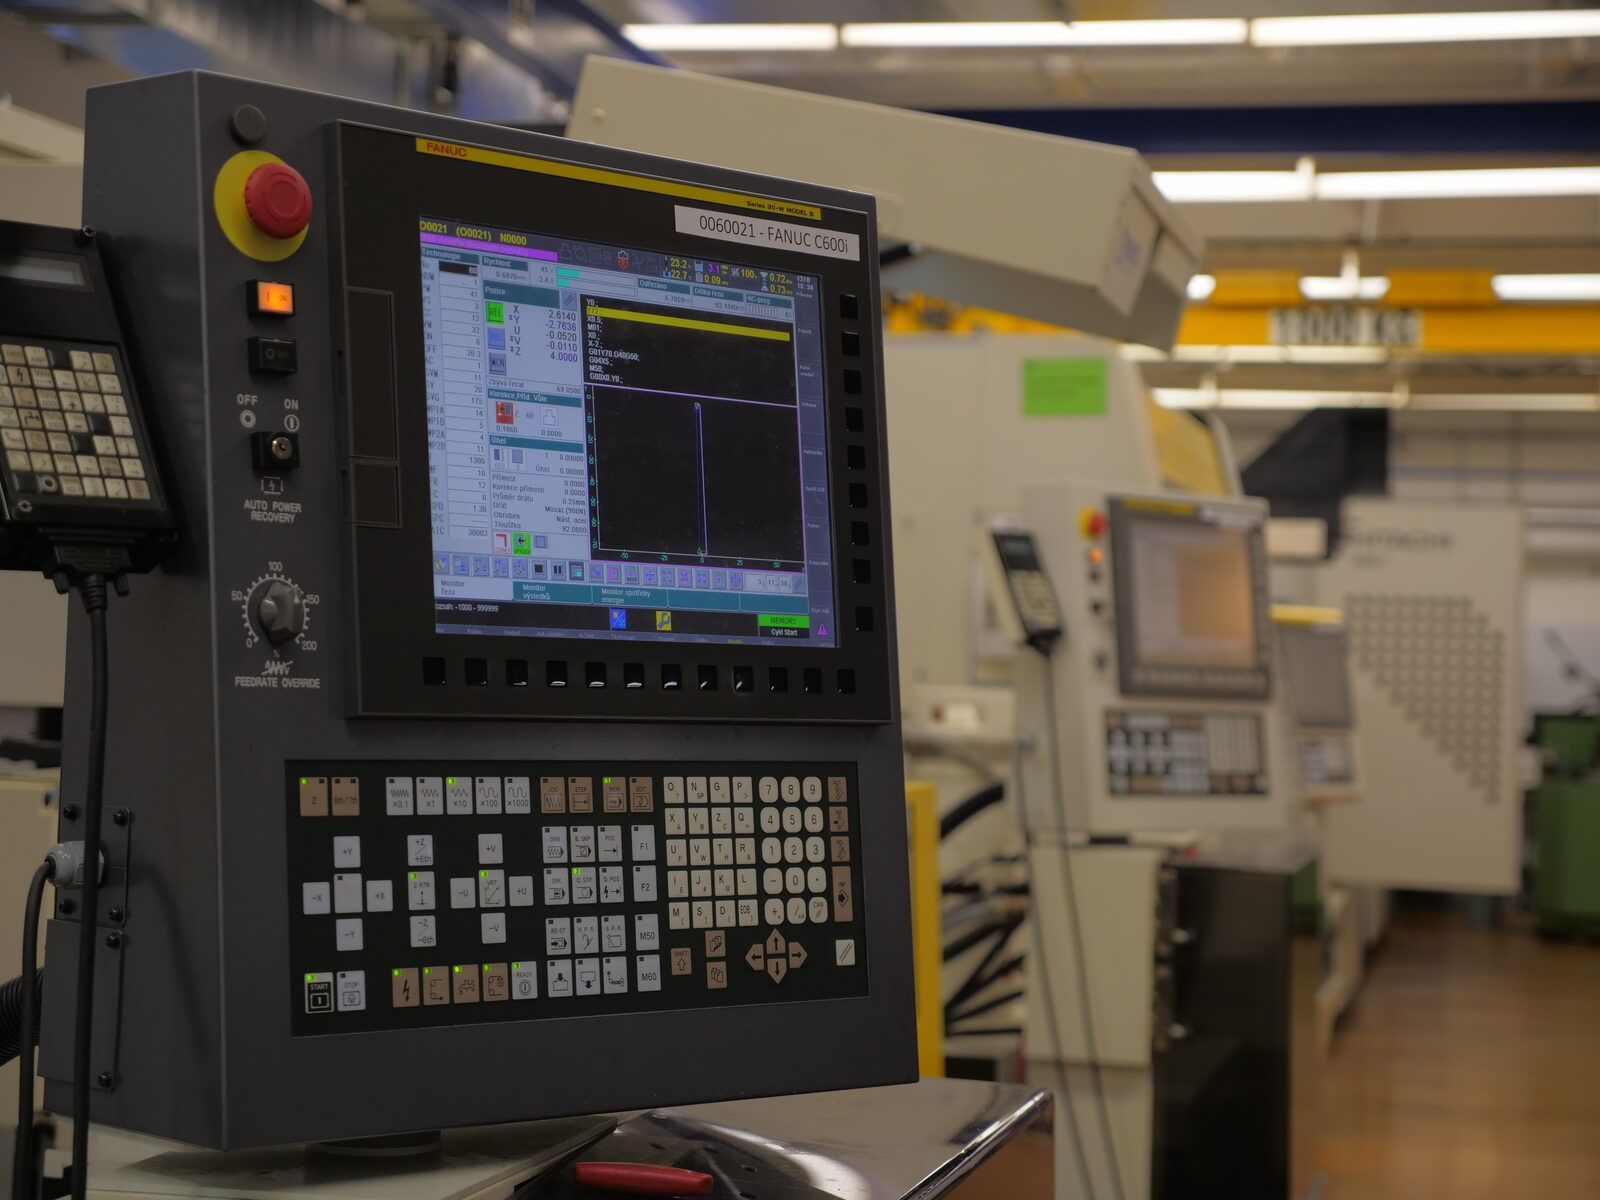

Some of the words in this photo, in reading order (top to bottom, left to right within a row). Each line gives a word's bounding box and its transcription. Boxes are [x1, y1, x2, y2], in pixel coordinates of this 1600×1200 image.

[426, 142, 467, 157] FANUC
[420, 221, 447, 233] O0021
[456, 226, 492, 242] (O0021)
[500, 233, 527, 245] N0000
[699, 215, 755, 238] 0060021
[768, 227, 810, 247] FANUC
[815, 234, 848, 253] C600i
[483, 258, 511, 267] Rychlost
[485, 287, 506, 295] Pozice
[514, 305, 519, 313] X
[549, 310, 575, 320] 2.6140
[546, 320, 576, 330] -2.7636
[514, 326, 520, 334] U
[546, 332, 577, 341] -0.0520
[547, 343, 577, 352] -0.0110
[550, 353, 577, 362] 4.0000
[489, 379, 503, 388] Zbývá
[237, 394, 258, 406] OFF
[284, 398, 298, 410] ON
[493, 483, 518, 492] Korekce
[244, 499, 267, 510] AUTO
[273, 501, 302, 512] POWER
[251, 510, 295, 523] RECOVERY
[494, 512, 520, 520] Obrobek
[269, 562, 282, 571] 100
[231, 591, 242, 600] 50
[523, 592, 550, 600] výsledků
[246, 639, 252, 648] 0
[302, 641, 317, 650] 200
[235, 676, 278, 688] FEEDRATE
[282, 677, 320, 688] OVERRIDE
[691, 783, 697, 791] N
[714, 782, 720, 791] G
[766, 785, 772, 794] 7
[788, 785, 794, 794] 8
[810, 785, 815, 795] 9
[670, 814, 674, 822] X
[693, 814, 698, 822] Y
[738, 813, 744, 822] Q
[768, 815, 773, 824] 4
[790, 815, 795, 825] 5
[811, 815, 817, 824] 6
[671, 845, 676, 853] U
[694, 845, 700, 853] V
[740, 844, 745, 852] R
[770, 846, 773, 856] 1
[792, 845, 796, 855] 2
[813, 845, 818, 855] 3
[696, 876, 700, 884] J
[719, 875, 724, 884] K
[793, 875, 798, 885] 0
[697, 907, 702, 916] S
[740, 905, 750, 914] EOB
[640, 932, 655, 940] M50
[642, 973, 656, 981] M60
